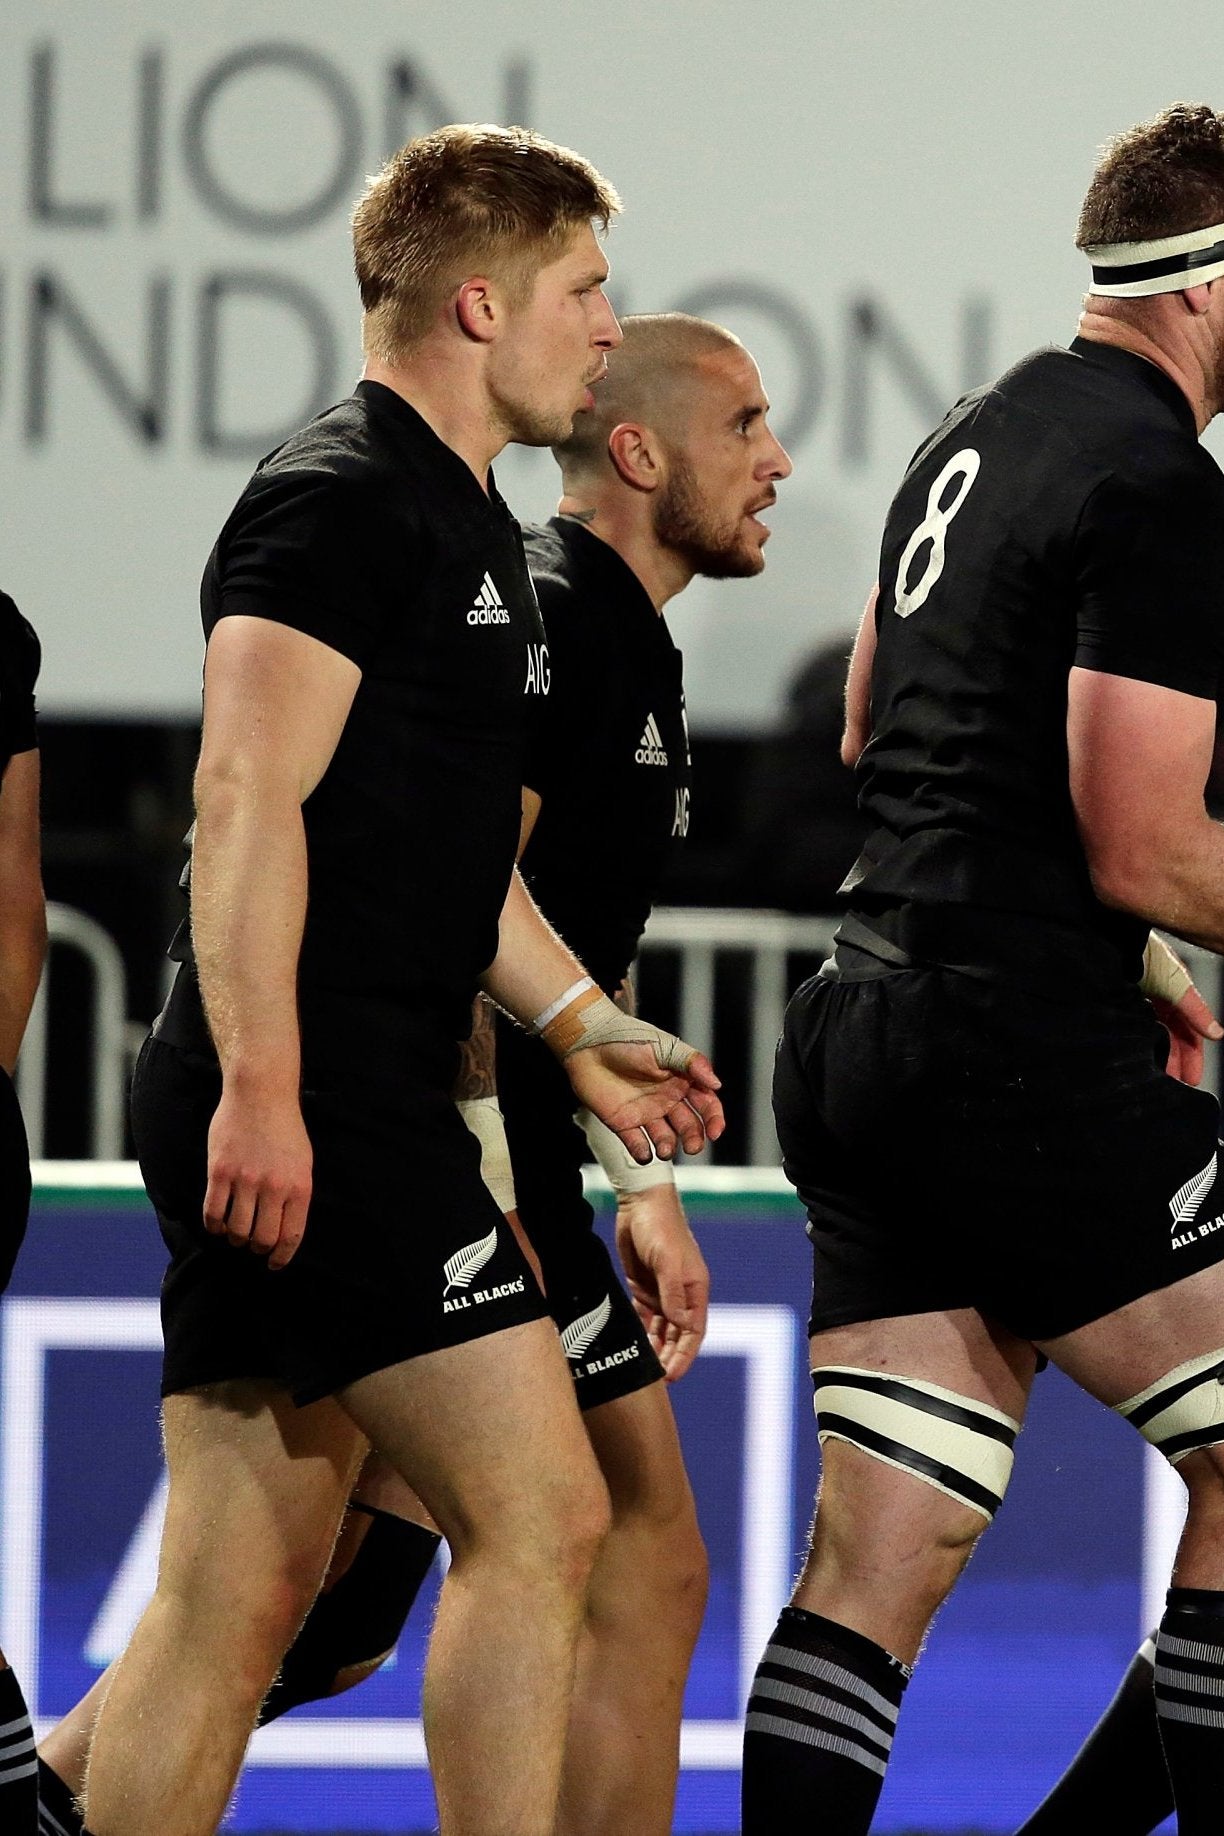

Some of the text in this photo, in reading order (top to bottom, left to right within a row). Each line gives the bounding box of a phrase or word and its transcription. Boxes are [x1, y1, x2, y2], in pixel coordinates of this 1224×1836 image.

[895, 448, 981, 619] 8
[466, 605, 511, 625] adidas
[524, 643, 551, 696] AIG
[634, 748, 668, 766] adidas
[1171, 1231, 1198, 1250] ALL
[443, 1279, 525, 1313] ALL BLACKS
[586, 1345, 639, 1375] BLACKS
